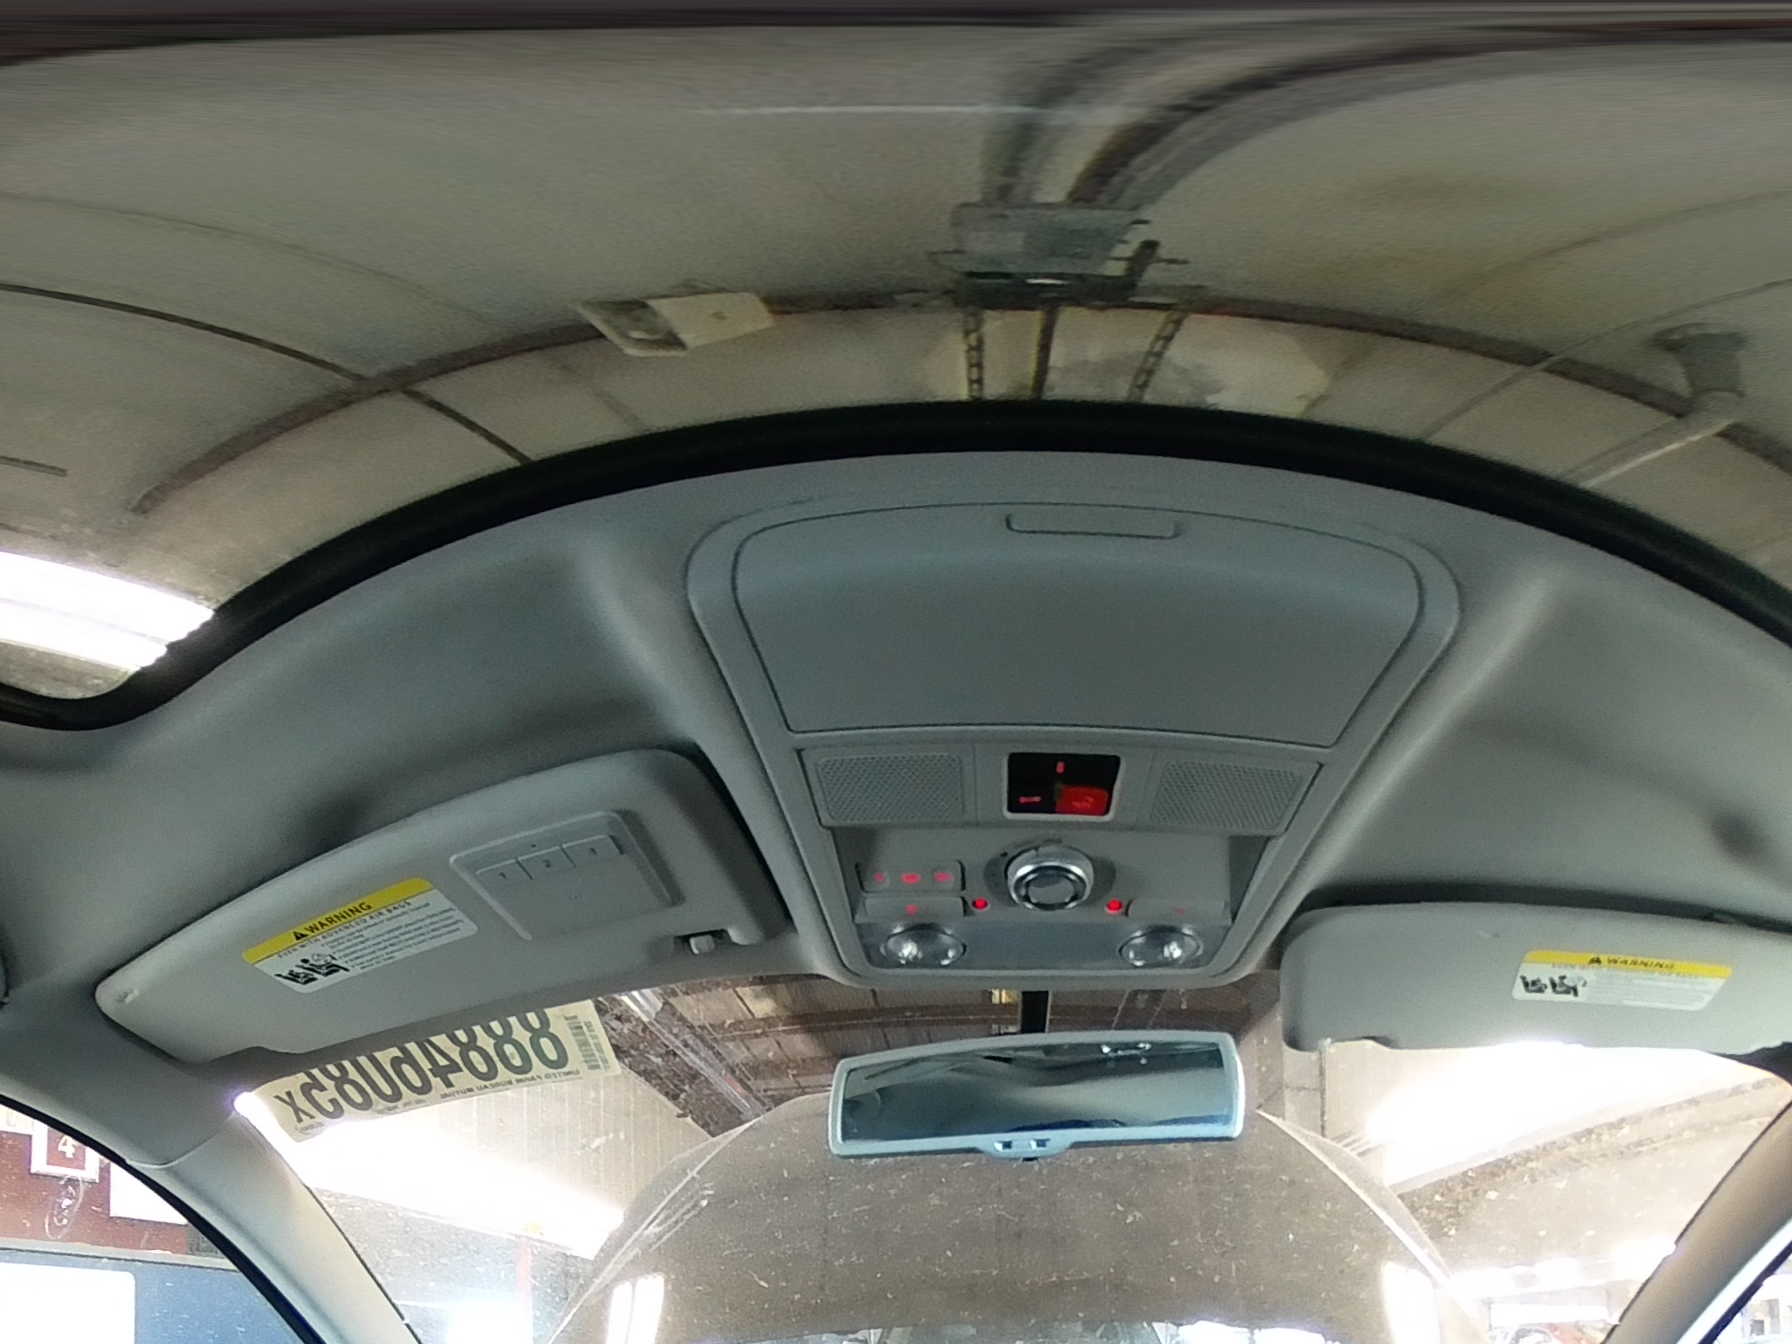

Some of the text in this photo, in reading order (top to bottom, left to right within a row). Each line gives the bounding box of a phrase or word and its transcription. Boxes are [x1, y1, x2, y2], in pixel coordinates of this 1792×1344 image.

[543, 859, 552, 869] 2
[304, 902, 373, 935] WARNING
[322, 919, 368, 940] ADVANCED
[369, 911, 384, 922] AIR
[1606, 956, 1675, 970] WARNING
[58, 1134, 75, 1158] 4
